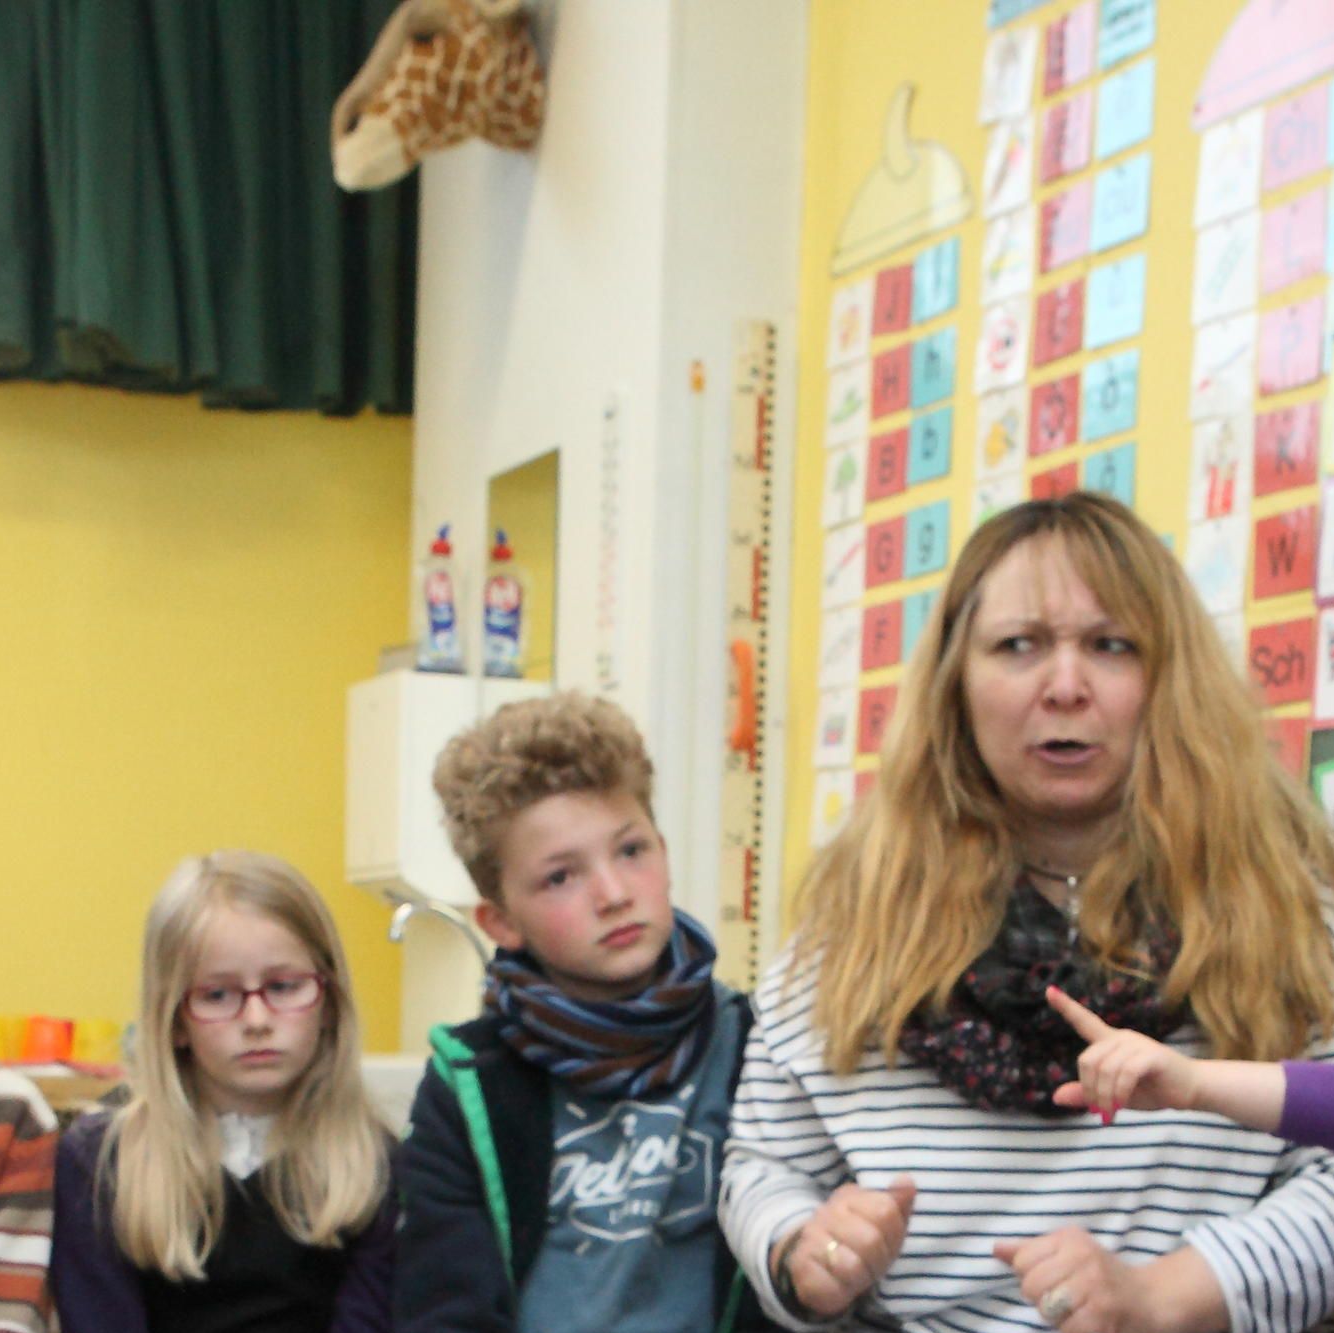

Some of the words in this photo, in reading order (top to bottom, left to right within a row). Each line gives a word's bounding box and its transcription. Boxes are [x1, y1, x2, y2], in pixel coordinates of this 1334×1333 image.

[1275, 430, 1302, 474] K
[1268, 530, 1300, 578] W
[1251, 643, 1306, 689] Sch
